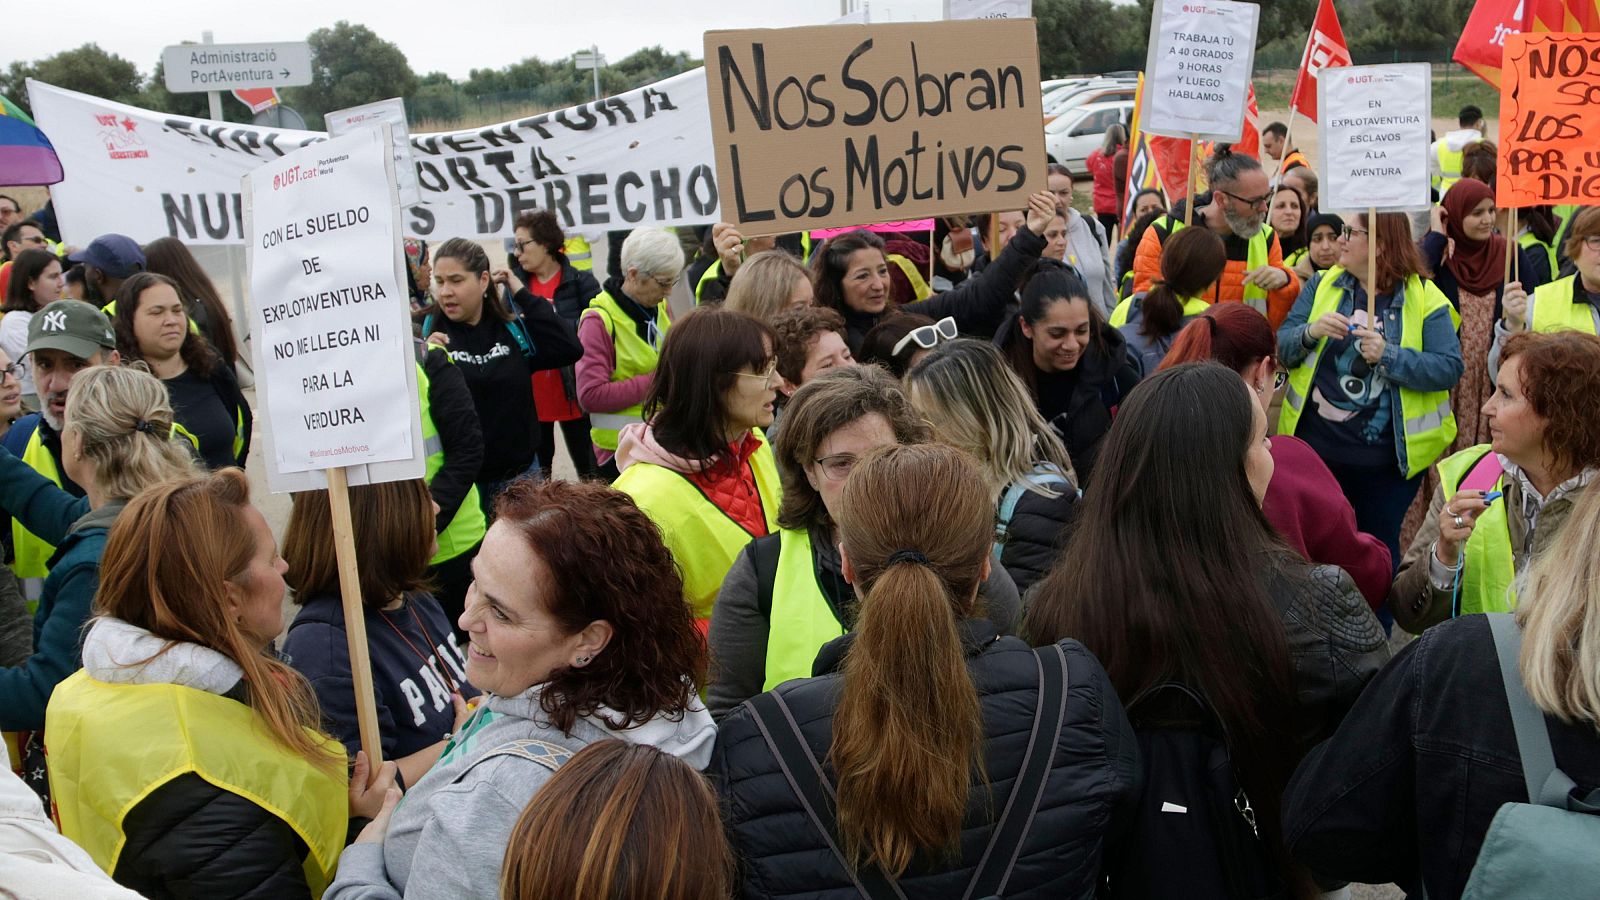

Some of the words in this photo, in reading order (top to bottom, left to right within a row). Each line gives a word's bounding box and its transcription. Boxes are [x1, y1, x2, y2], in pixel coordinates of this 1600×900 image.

[1174, 32, 1220, 44] TRABAJA
[1222, 36, 1234, 46] TÚ
[190, 48, 277, 65] Administració
[1169, 46, 1176, 54] A
[1178, 48, 1189, 56] 40
[1192, 48, 1234, 60] GRADOS
[1178, 62, 1184, 70] 9
[1187, 62, 1222, 73] HORAS
[190, 68, 274, 83] PortAventura
[1177, 76, 1183, 84] Y
[1186, 77, 1220, 88] LUEGO
[718, 42, 836, 133] Nos
[842, 38, 1025, 126] Sobran
[1168, 89, 1224, 102] HABLAMOS
[1368, 100, 1382, 108] EN
[1332, 116, 1420, 128] EXPLOTAVENTURA
[1516, 110, 1582, 142] LOS
[1350, 133, 1401, 144] ESCLAVOS
[318, 154, 349, 166] PortAventura
[1365, 151, 1371, 159] A
[1374, 150, 1386, 158] LA
[1510, 148, 1567, 176] POR
[282, 165, 317, 187] UGT.cat
[320, 167, 333, 175] World
[730, 144, 834, 224] Los
[845, 130, 1026, 212] Motivos
[1350, 168, 1401, 177] AVENTURA
[262, 226, 282, 248] CON
[286, 224, 303, 240] EL
[306, 206, 369, 235] SUELDO
[302, 257, 321, 275] DE
[262, 282, 386, 324] EXPLOTAVENTURA
[274, 342, 294, 360] NO
[296, 337, 309, 356] ME
[310, 328, 361, 352] LLEGA
[364, 324, 380, 342] NI
[302, 374, 329, 394] PARA
[333, 370, 354, 388] LA
[304, 407, 365, 430] VERDURA
